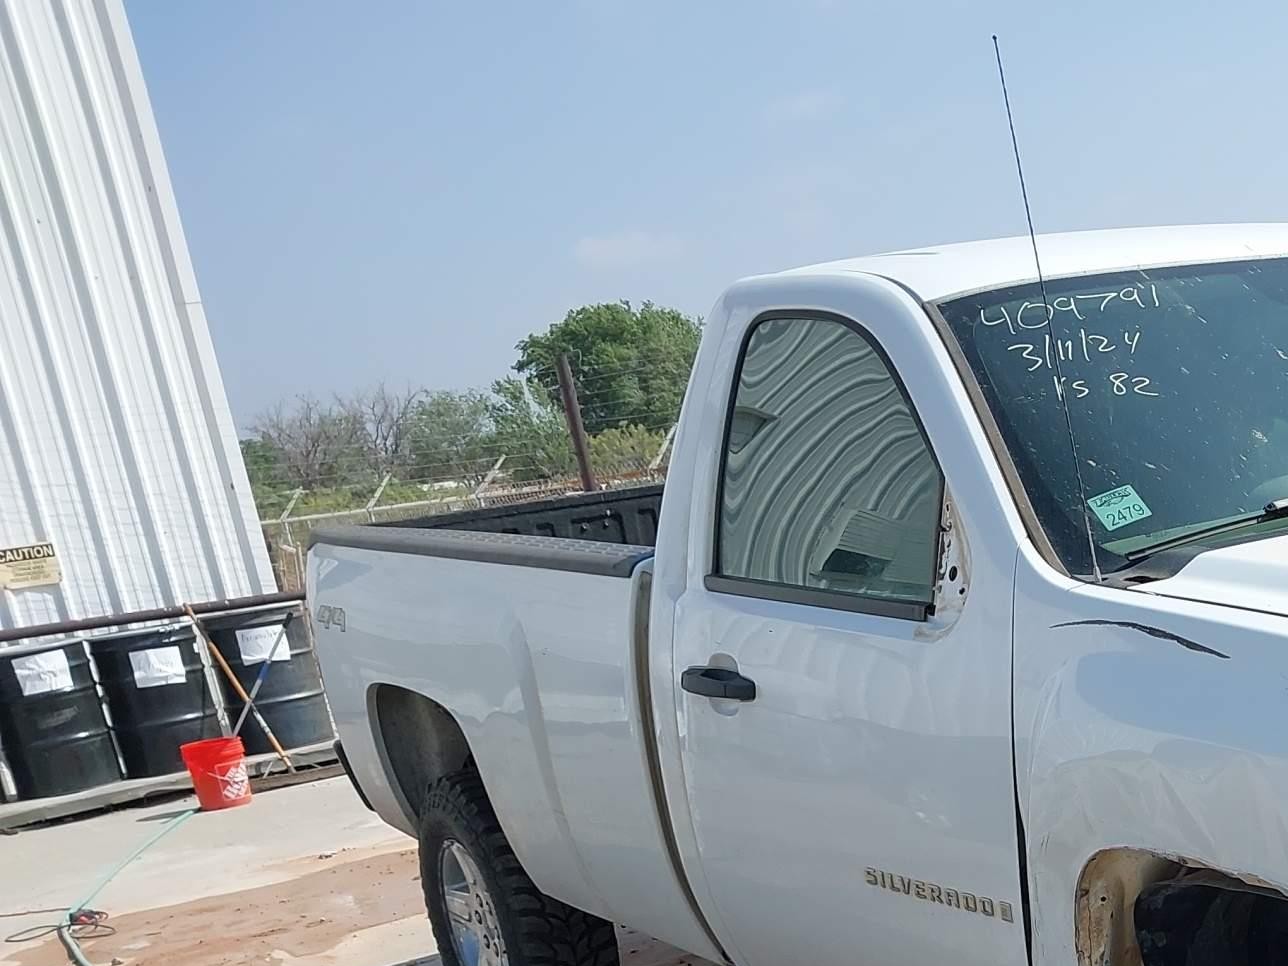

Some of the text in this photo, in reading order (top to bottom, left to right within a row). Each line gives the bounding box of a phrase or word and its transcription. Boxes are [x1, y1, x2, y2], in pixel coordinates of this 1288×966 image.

[980, 284, 1160, 335] 409791
[1109, 372, 1159, 396] 82
[1106, 503, 1145, 527] 2479
[0, 545, 54, 563] CAUTION
[864, 867, 995, 917] SILVERADO
